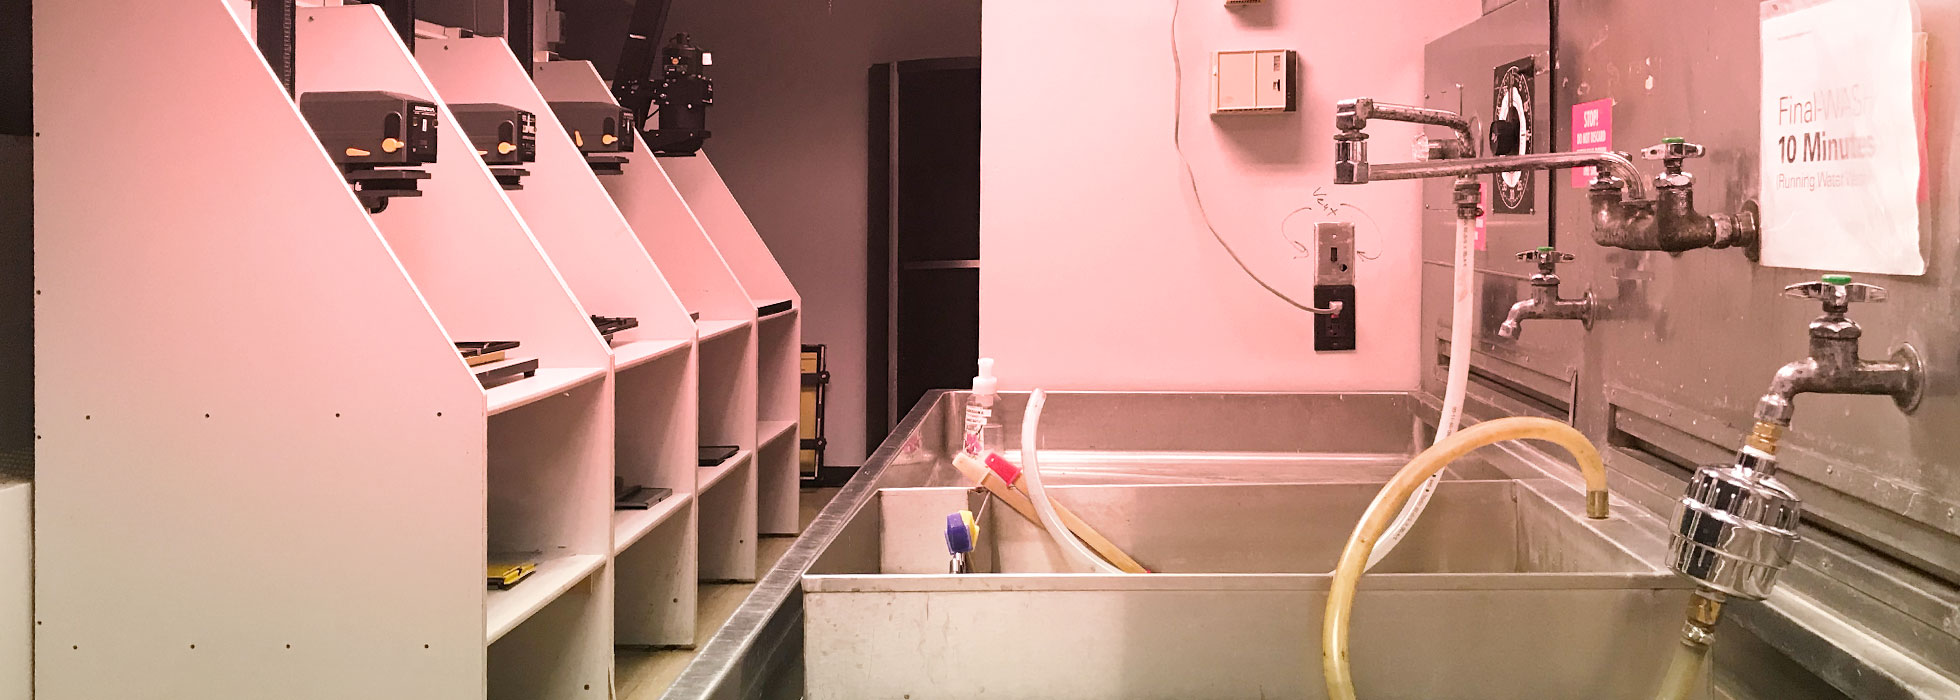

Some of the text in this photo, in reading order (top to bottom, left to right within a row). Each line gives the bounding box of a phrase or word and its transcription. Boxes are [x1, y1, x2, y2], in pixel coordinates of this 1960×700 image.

[1584, 108, 1598, 128] STOP!
[1778, 131, 1875, 164] 10 Minutes
